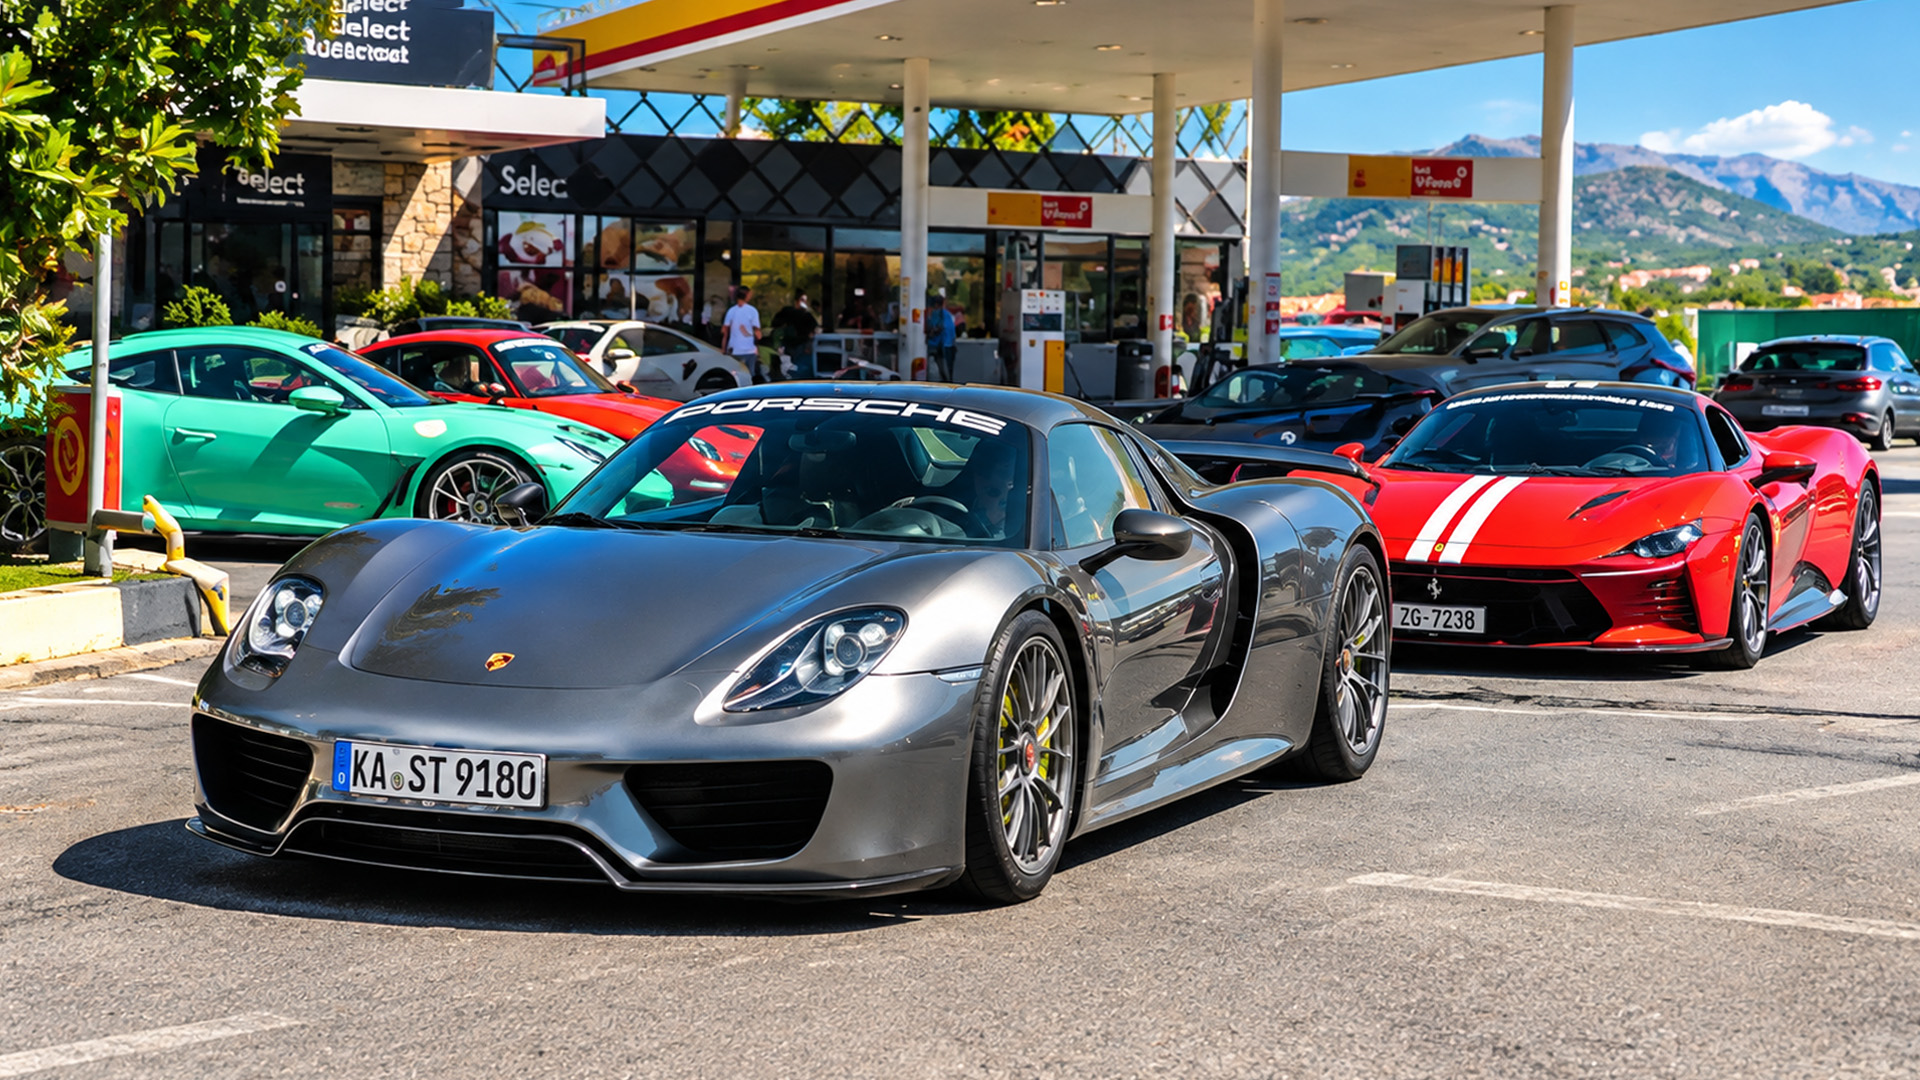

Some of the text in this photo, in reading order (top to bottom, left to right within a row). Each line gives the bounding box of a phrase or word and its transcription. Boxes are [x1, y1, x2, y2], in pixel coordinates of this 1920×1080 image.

[664, 398, 1007, 435] PORSCHE
[1400, 607, 1475, 630] ZG-7238
[352, 749, 387, 790] KA
[408, 755, 447, 794] ST
[455, 757, 537, 800] 9180
